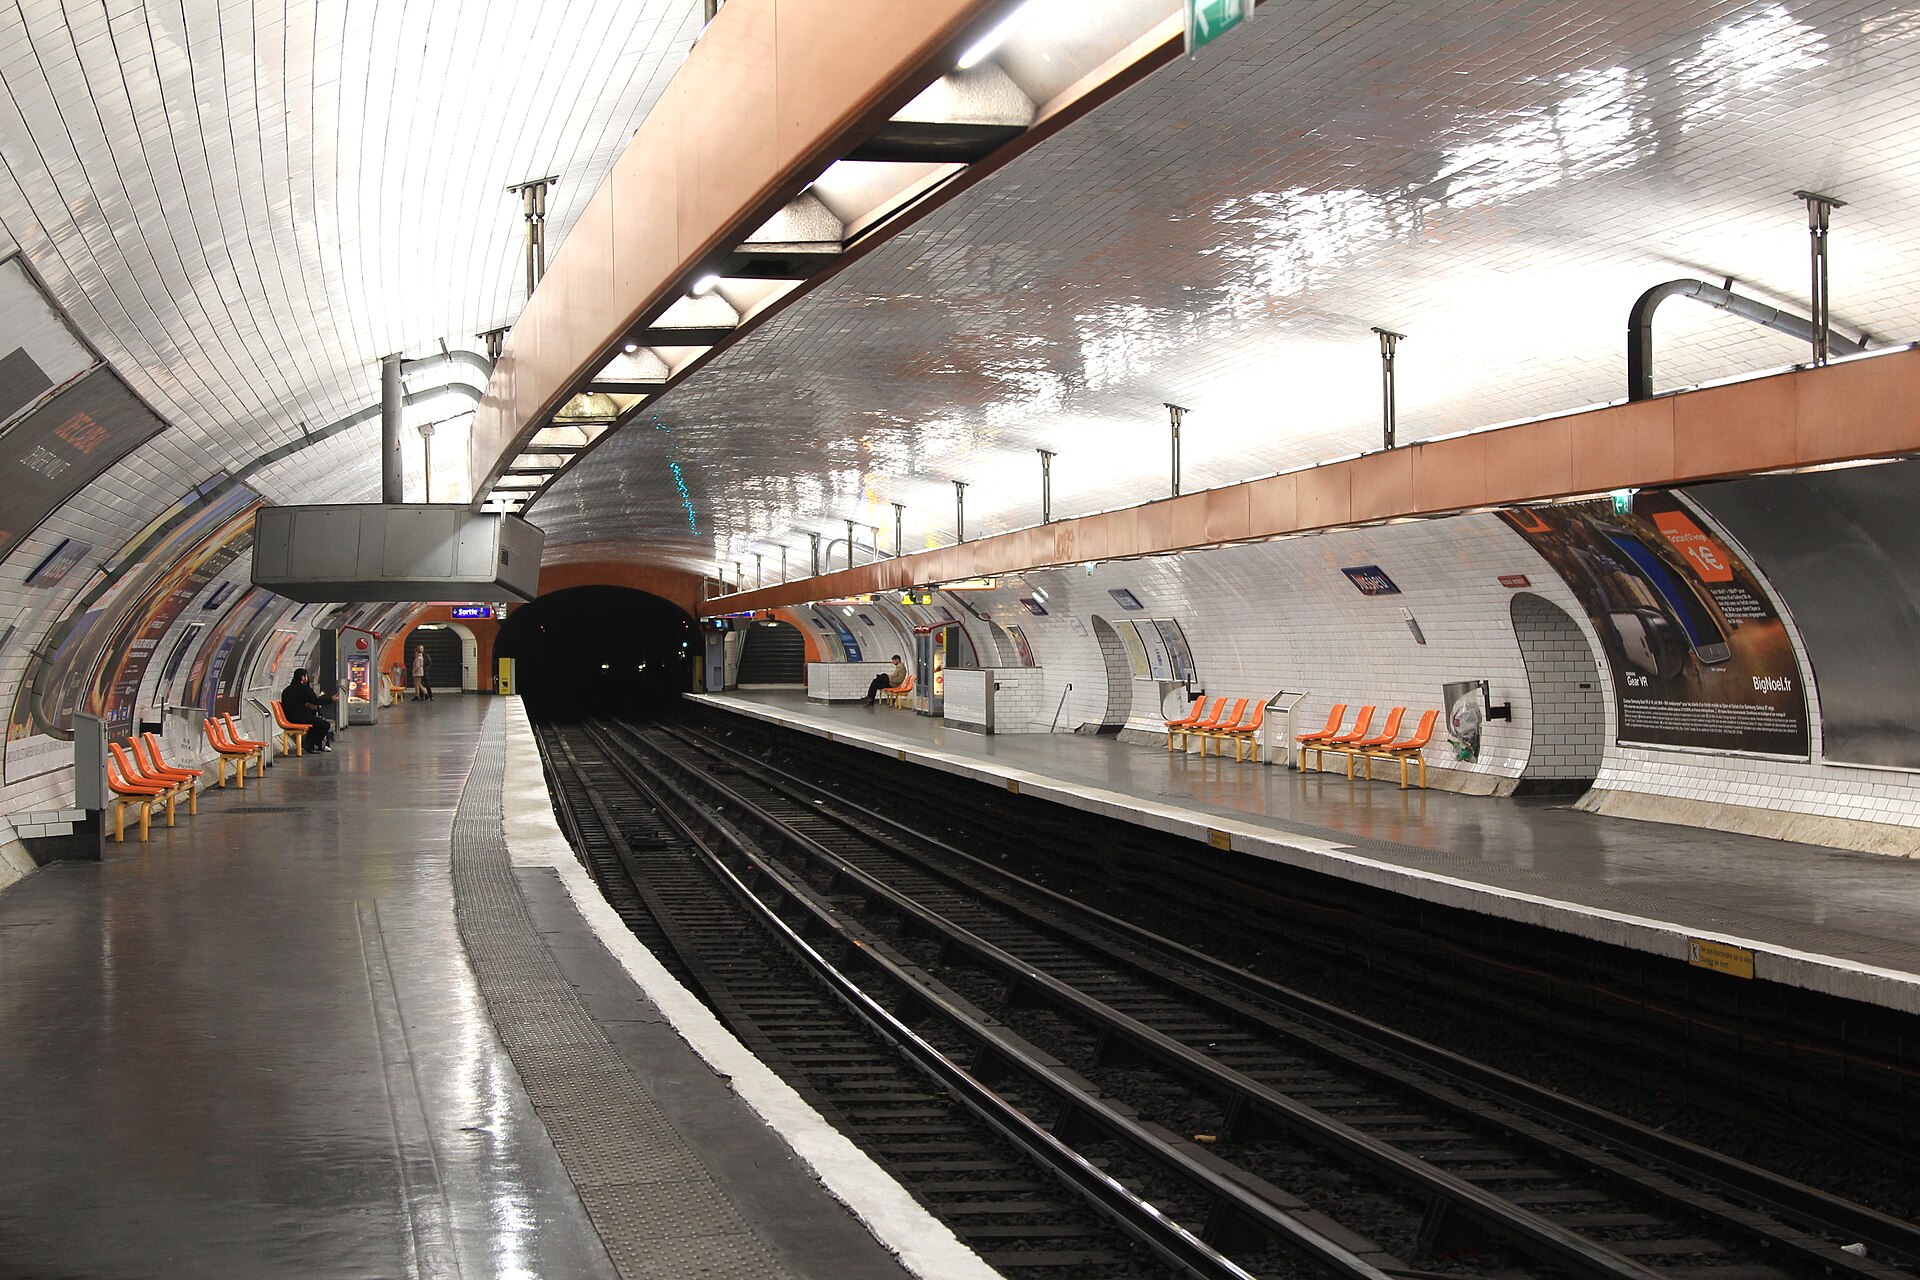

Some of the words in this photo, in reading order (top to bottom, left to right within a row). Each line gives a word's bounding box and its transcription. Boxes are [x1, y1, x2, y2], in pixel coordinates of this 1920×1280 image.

[1688, 546, 1724, 570] 1€
[1350, 572, 1389, 590] Jussieu
[458, 608, 478, 616] Sortie
[1627, 675, 1639, 686] Gear
[1639, 676, 1648, 687] VR
[1752, 676, 1791, 694] BigNoel.fr
